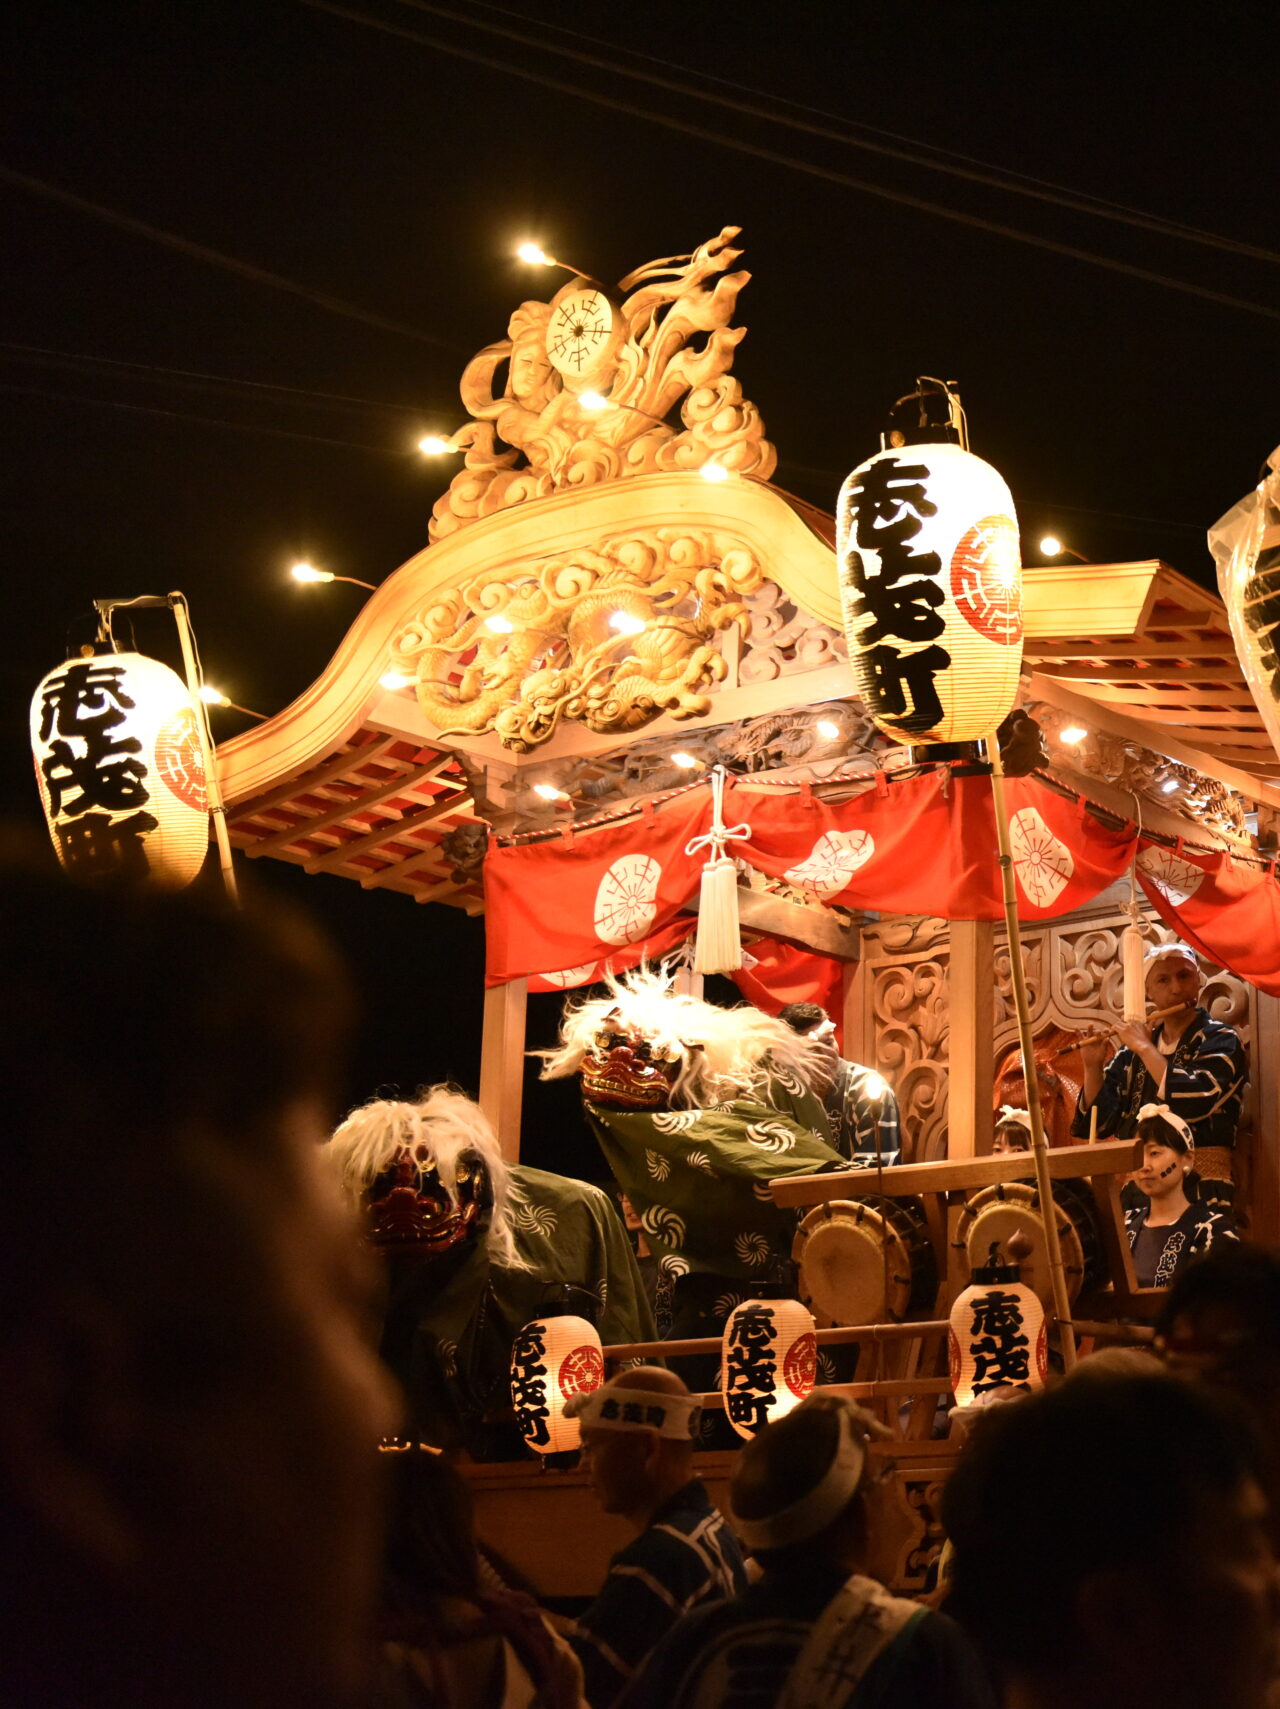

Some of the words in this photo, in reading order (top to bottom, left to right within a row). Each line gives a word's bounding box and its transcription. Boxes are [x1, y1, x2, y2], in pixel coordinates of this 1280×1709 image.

[845, 457, 952, 732] 志茂町
[39, 663, 160, 880] 志茂町
[511, 1323, 551, 1446] 志茂町
[726, 1304, 778, 1433] 志茂町
